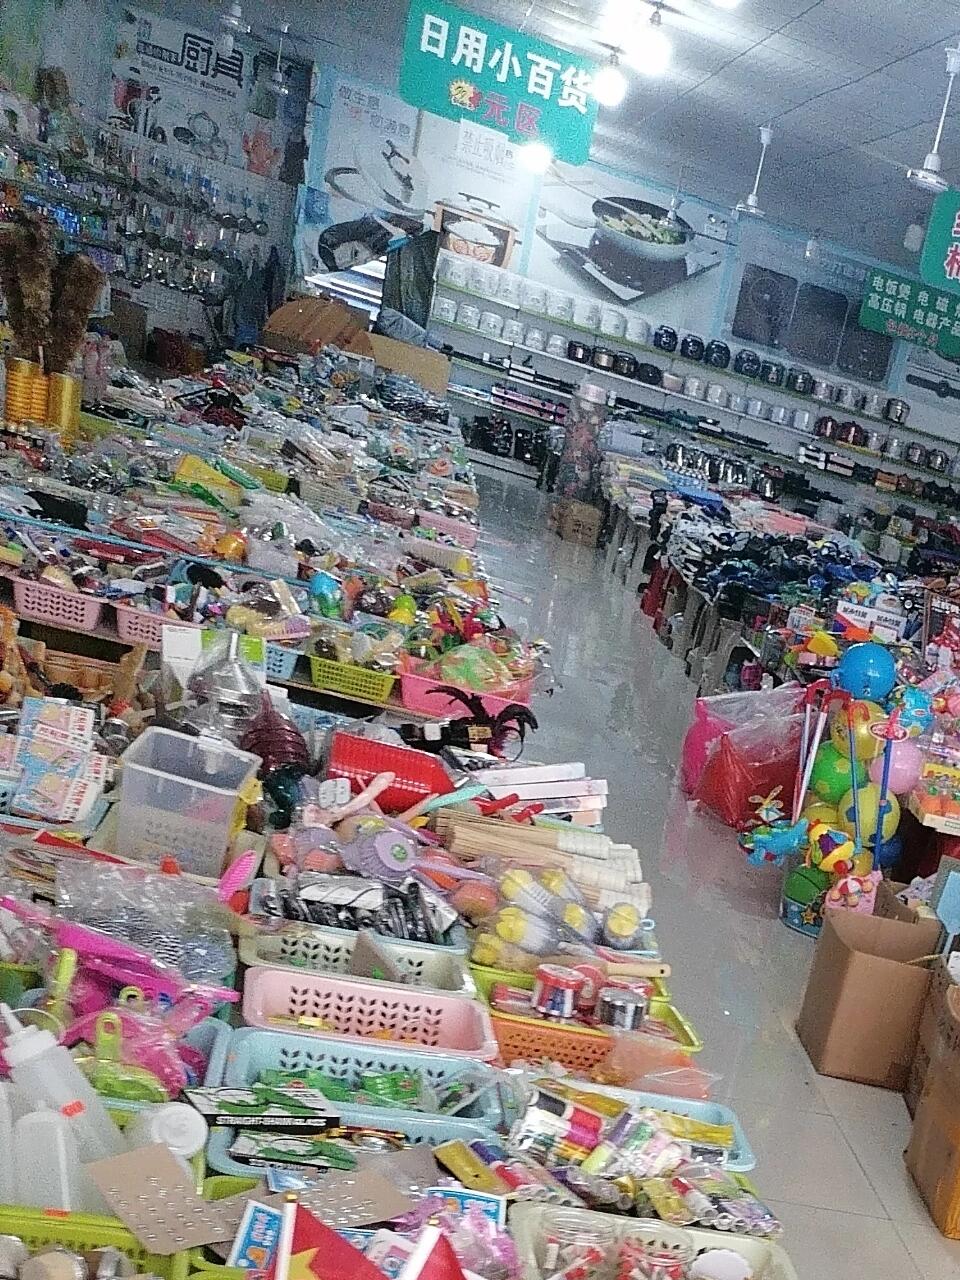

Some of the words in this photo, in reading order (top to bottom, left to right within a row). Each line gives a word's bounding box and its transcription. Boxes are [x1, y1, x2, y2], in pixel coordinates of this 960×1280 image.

[420, 14, 594, 114] 日用小百货
[867, 292, 910, 320] 高压锅
